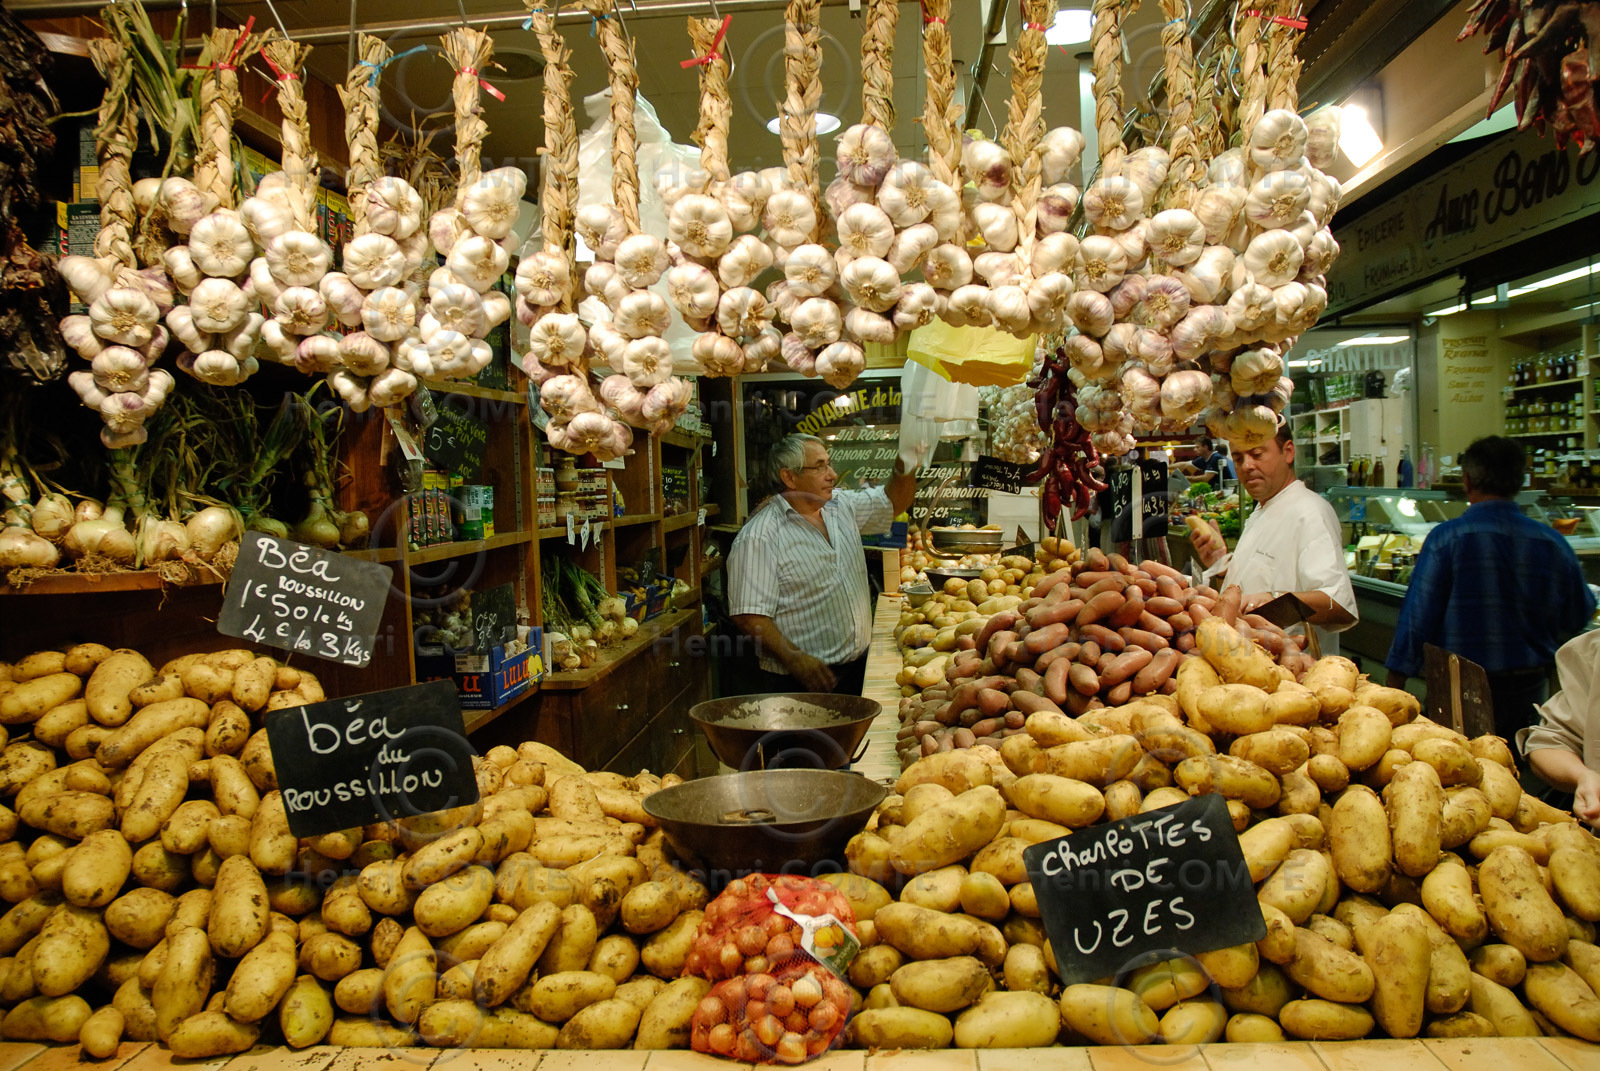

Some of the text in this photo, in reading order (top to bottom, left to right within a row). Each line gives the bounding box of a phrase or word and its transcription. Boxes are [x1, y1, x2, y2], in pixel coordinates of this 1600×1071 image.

[1306, 347, 1411, 374] CHANTILLY
[872, 386, 887, 407] de
[874, 447, 899, 460] DOU
[257, 537, 340, 581] Béa
[279, 576, 364, 611] ROUSSILLON
[319, 632, 340, 658] 3
[503, 659, 530, 690] LULU
[301, 701, 406, 754] béa
[377, 744, 411, 765] du
[1111, 857, 1169, 892] DE
[1074, 896, 1195, 954] UZES
